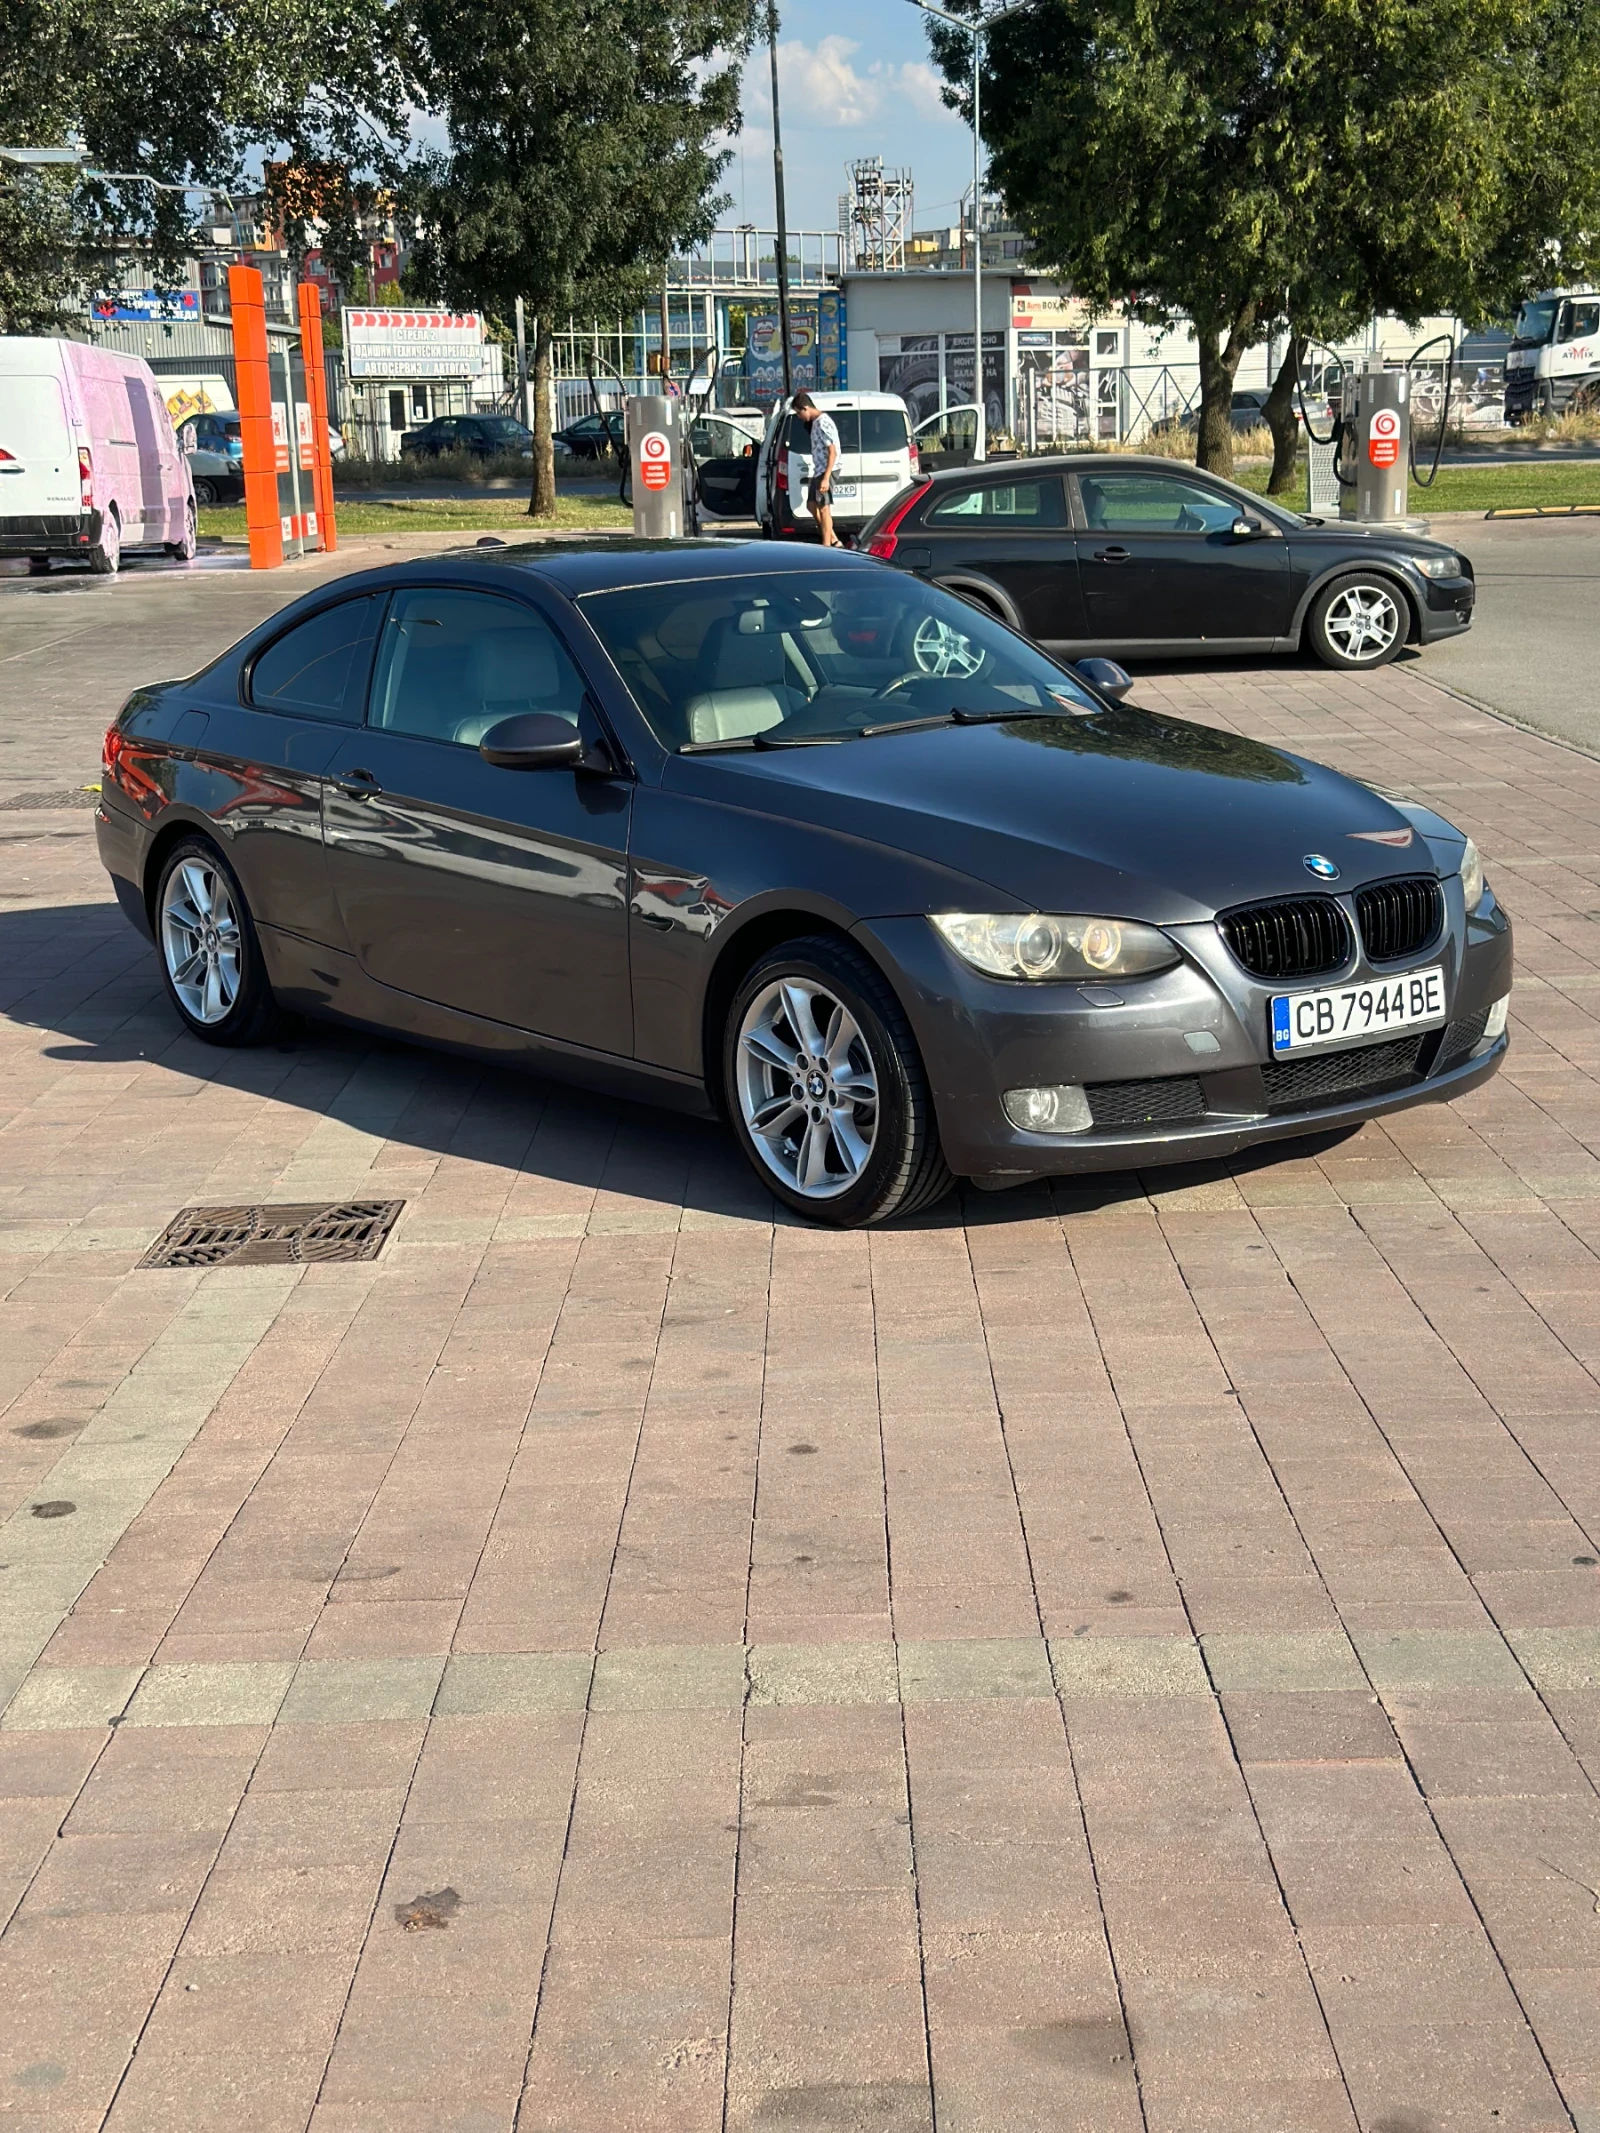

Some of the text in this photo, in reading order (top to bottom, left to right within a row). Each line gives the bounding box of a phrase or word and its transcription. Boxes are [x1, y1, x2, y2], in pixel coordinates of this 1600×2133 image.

[397, 329, 437, 342] СТРЕЛА 2
[352, 344, 481, 360] ГОДИШНИ ТЕХНИЧЕСКИ ПРЕГЛЕДИ
[364, 361, 423, 375] АВТОСЕРВИЗ
[433, 362, 471, 375] АВТОГАЗ
[986, 368, 997, 377] НА
[1296, 975, 1441, 1039] CB 7944 BE
[1275, 1029, 1290, 1042] BG
